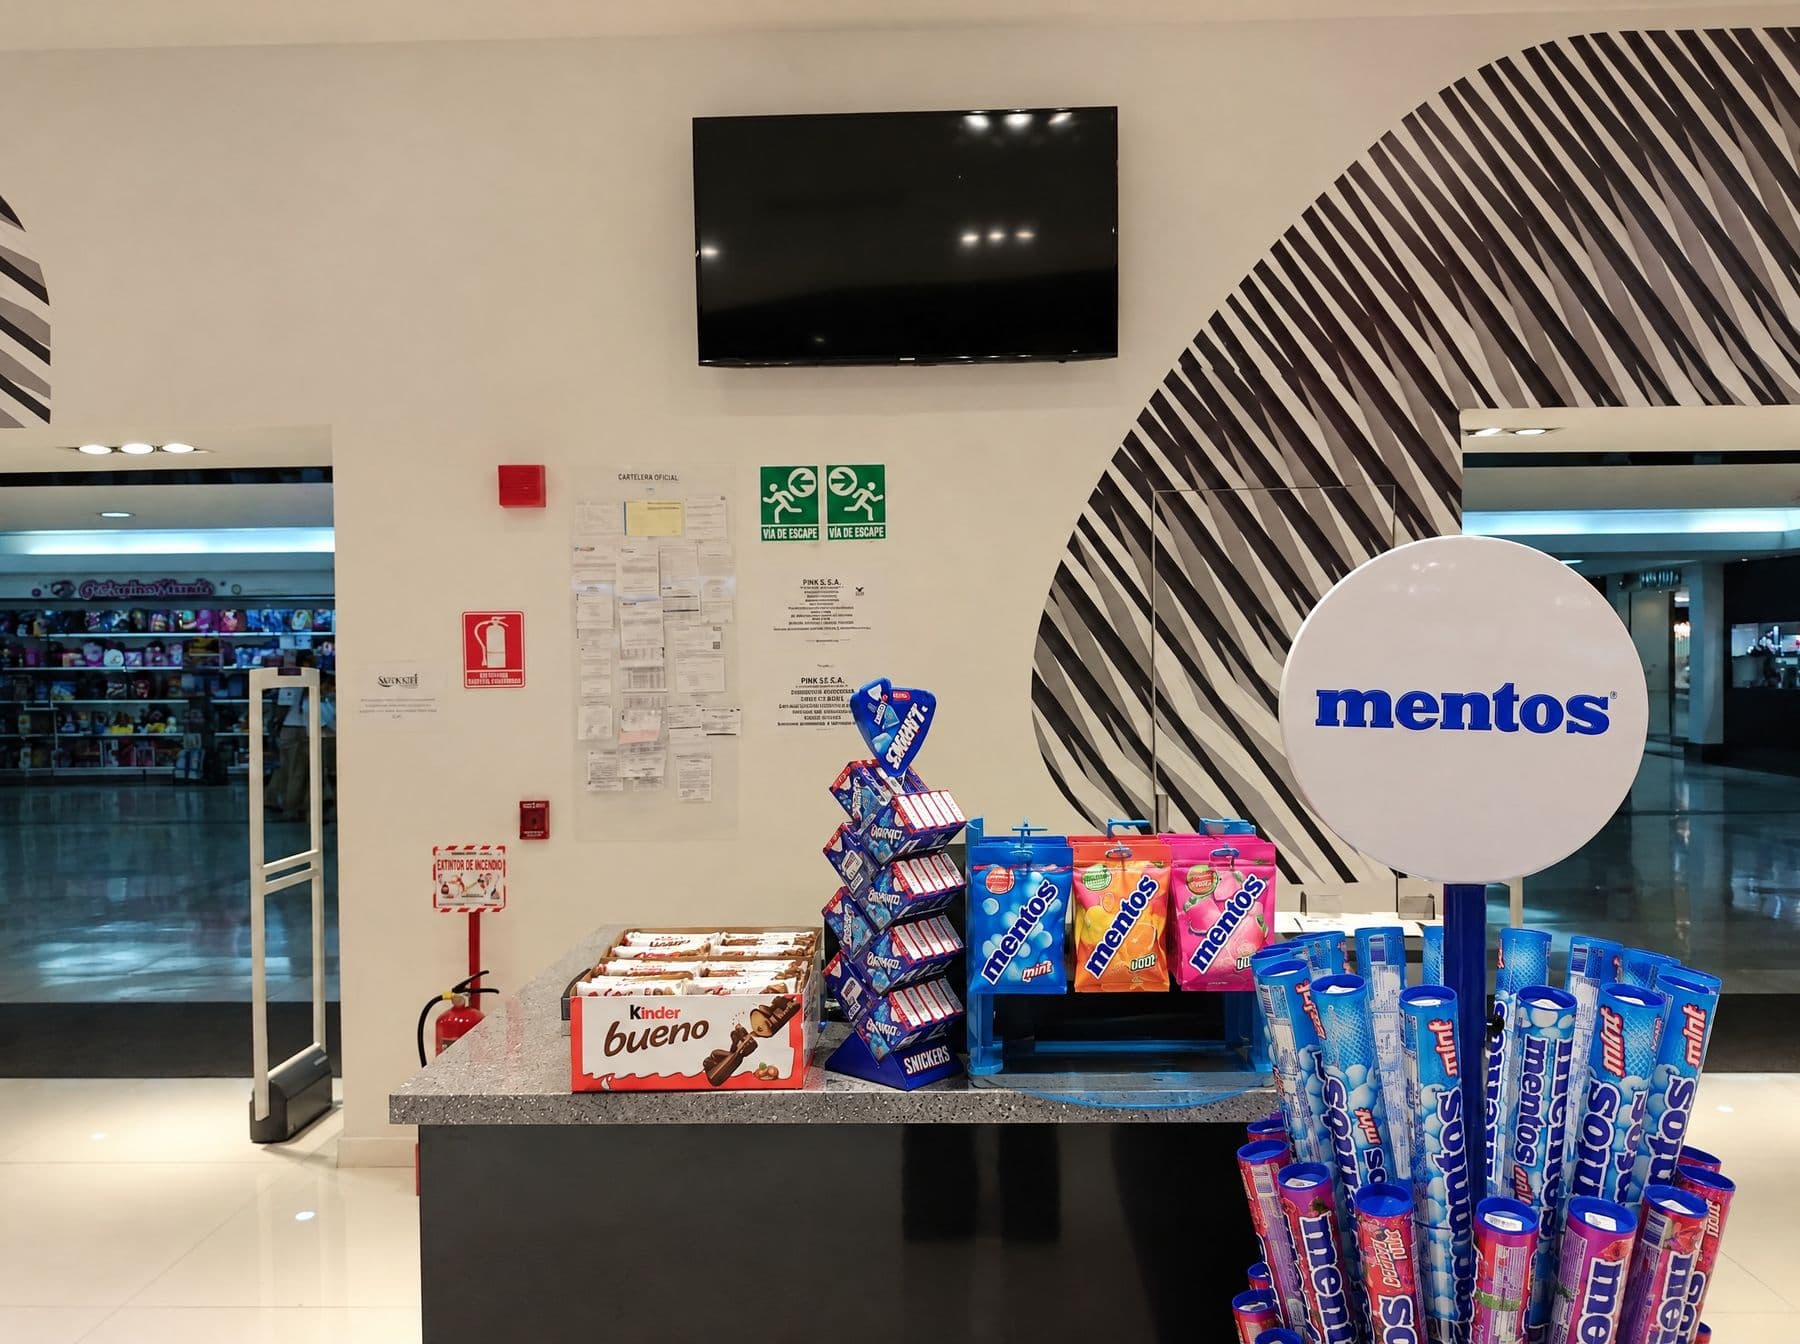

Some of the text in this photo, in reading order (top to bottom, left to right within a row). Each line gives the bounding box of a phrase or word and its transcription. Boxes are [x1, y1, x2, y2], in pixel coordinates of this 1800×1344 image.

[617, 473, 679, 481] CARTELERA OFICIAL
[777, 527, 787, 539] DE
[788, 527, 818, 539] ESCAPE
[843, 527, 853, 538] DE
[854, 526, 885, 538] ESCAPE
[1315, 682, 1610, 735] mentos
[437, 859, 502, 870] EXTINTOR DE INCENDIO
[982, 881, 1057, 984] mentos
[1086, 875, 1158, 978] mentos
[1190, 875, 1266, 973] mentos
[1022, 960, 1053, 983] mint
[603, 1020, 709, 1057] bueno
[629, 1004, 682, 1020] Kinder
[1600, 1004, 1626, 1077] mint
[1681, 1003, 1707, 1068] mint
[903, 1046, 950, 1075] SNICKERS
[1515, 1033, 1549, 1166] mentos
[1572, 1079, 1619, 1200] ntos
[1645, 1076, 1696, 1186] ntos
[1301, 1213, 1356, 1344] ment
